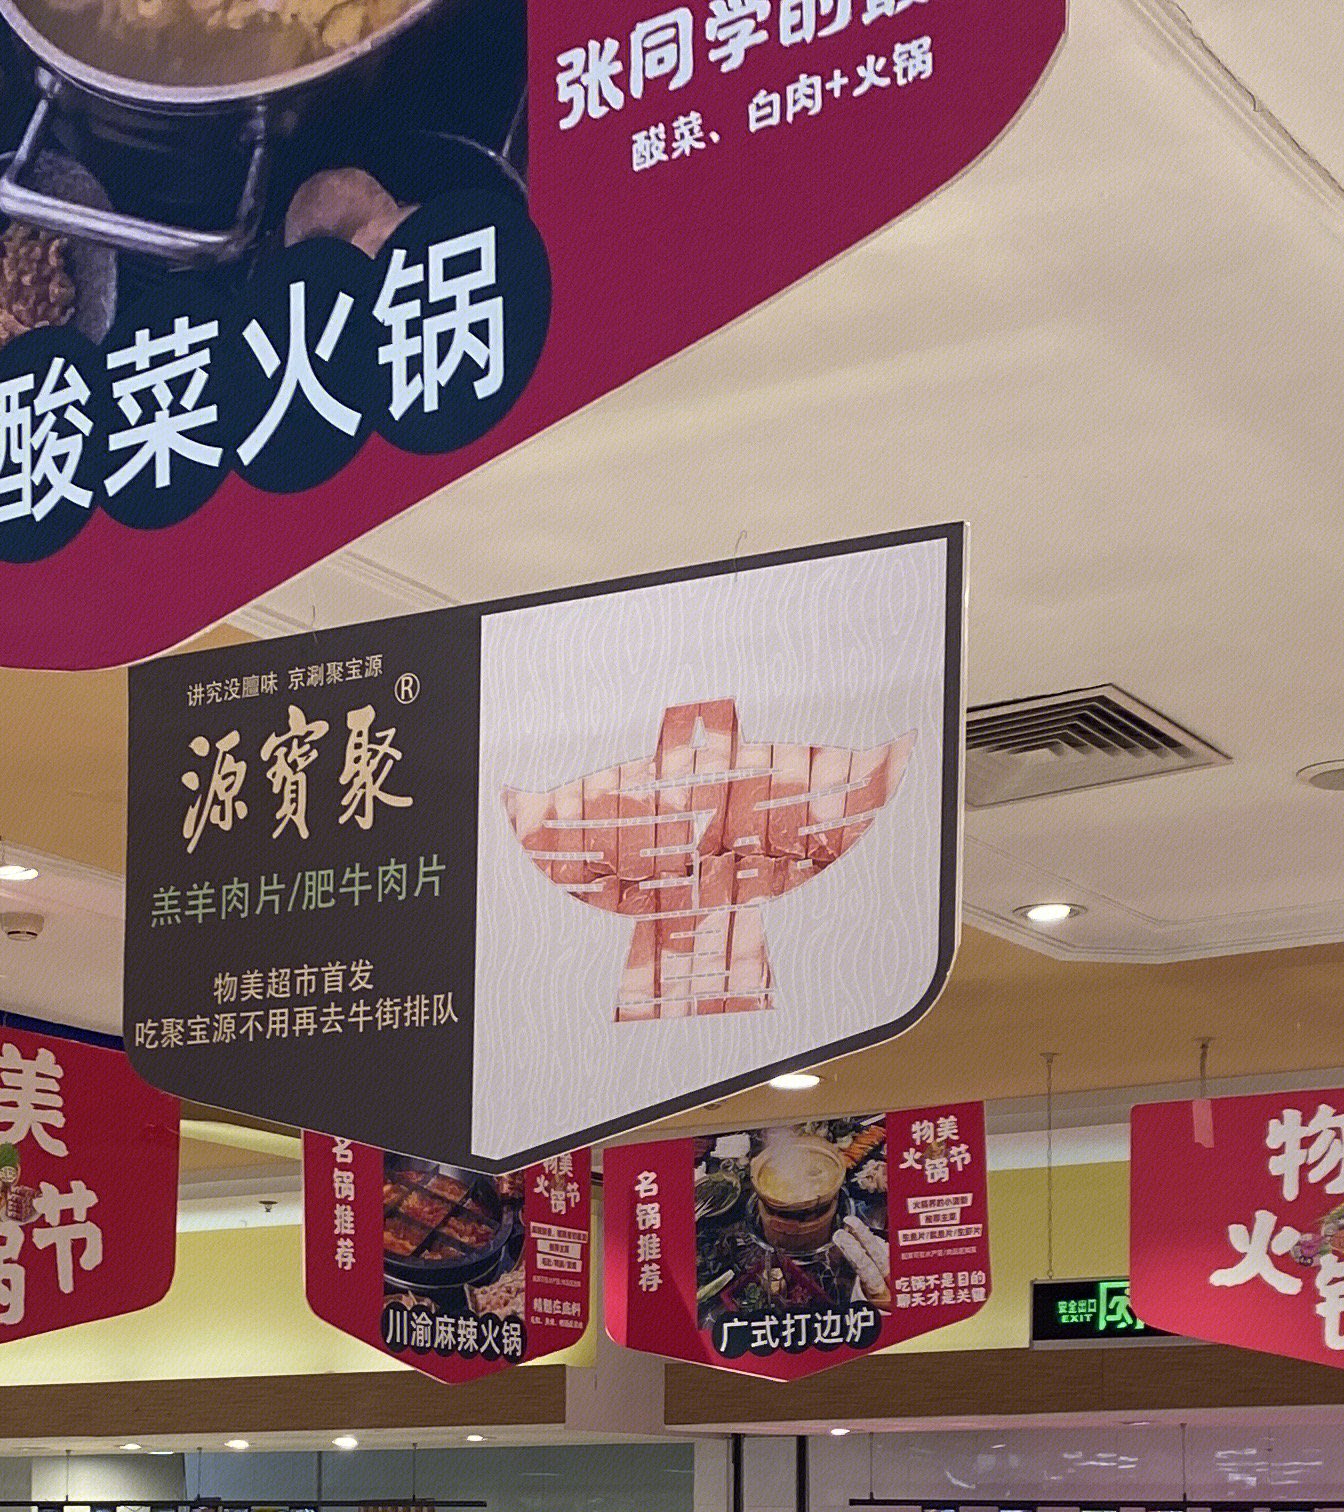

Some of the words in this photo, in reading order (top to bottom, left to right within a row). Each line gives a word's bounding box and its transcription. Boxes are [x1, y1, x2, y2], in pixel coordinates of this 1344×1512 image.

[150, 854, 447, 928] 羔羊肉片/肥牛肉片
[213, 959, 375, 1004] 物美超市首发
[134, 992, 458, 1050] 吃聚宝源不用再去牛街排队
[911, 1116, 960, 1146] 物美
[899, 1144, 971, 1184] 火锅节
[533, 1174, 580, 1215] 火锅节
[634, 1171, 664, 1292] 名锅推荐
[1058, 1299, 1096, 1313] 安全出口
[1061, 1314, 1093, 1323] EXIT
[386, 1308, 523, 1357] 川渝麻辣火锅
[720, 1307, 876, 1352] 广式打边炉
